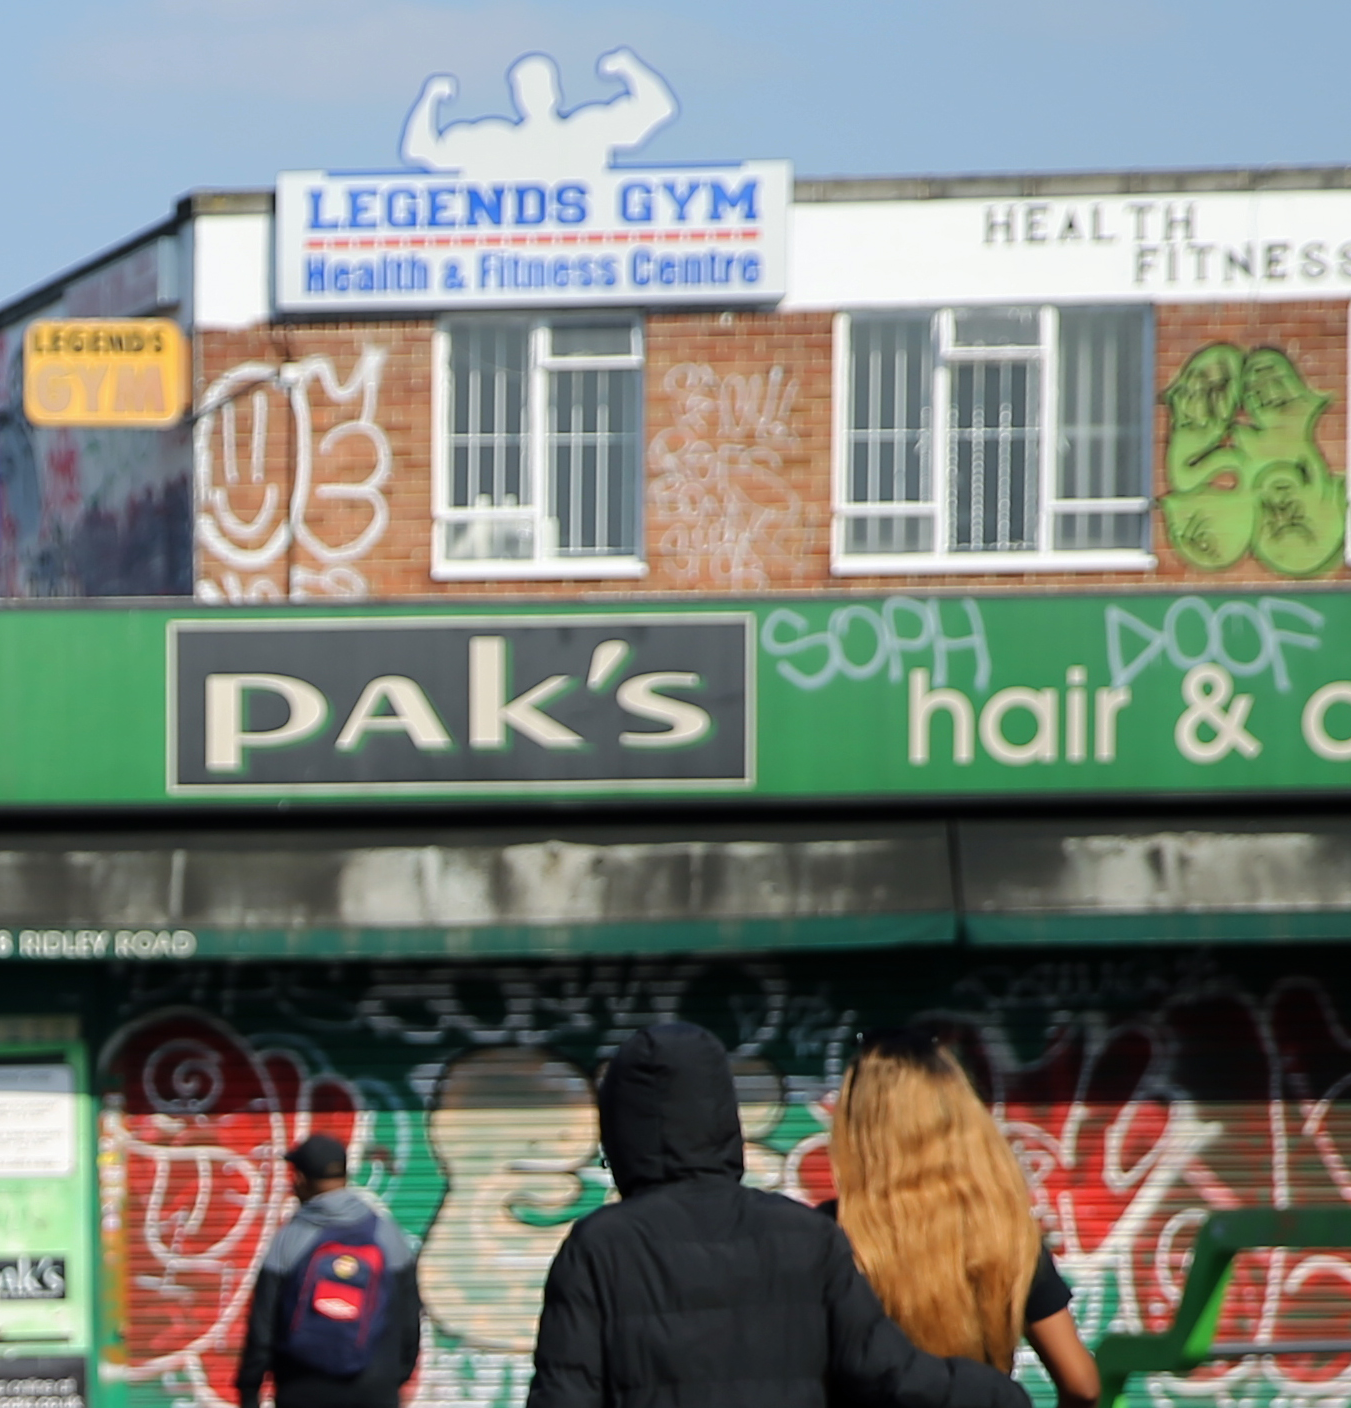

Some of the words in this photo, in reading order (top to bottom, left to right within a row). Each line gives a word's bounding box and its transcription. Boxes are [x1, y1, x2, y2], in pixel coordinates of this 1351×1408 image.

[307, 182, 589, 230] LEGENDS
[620, 176, 759, 223] GYM
[983, 201, 1199, 243] HEALTH
[306, 252, 429, 293] Health
[442, 259, 467, 290] &
[477, 250, 616, 289] Fitness
[630, 248, 761, 288] Centre
[34, 327, 164, 353] LEGENDS
[36, 363, 167, 412] GYM
[907, 665, 1132, 766] hair
[1174, 662, 1264, 765] &
[19, 930, 111, 959] RIDLEY
[115, 930, 197, 959] ROAD
